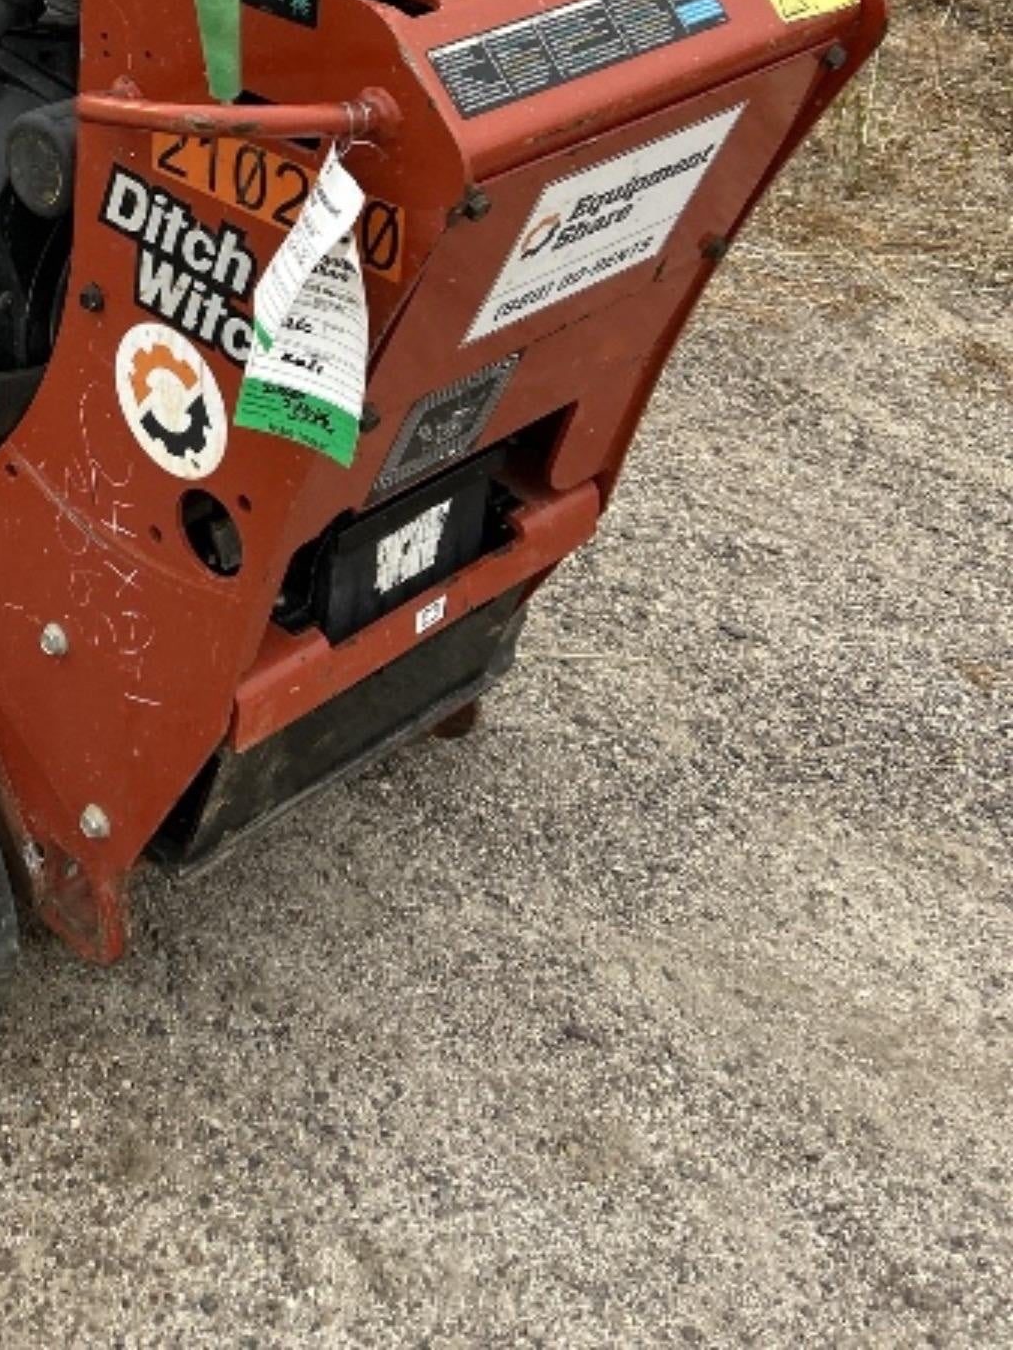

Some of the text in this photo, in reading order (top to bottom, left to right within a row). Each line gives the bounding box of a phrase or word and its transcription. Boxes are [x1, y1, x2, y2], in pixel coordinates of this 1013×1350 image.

[103, 170, 254, 296] Ditch
[156, 130, 400, 272] 21020
[138, 249, 254, 363] Witc
